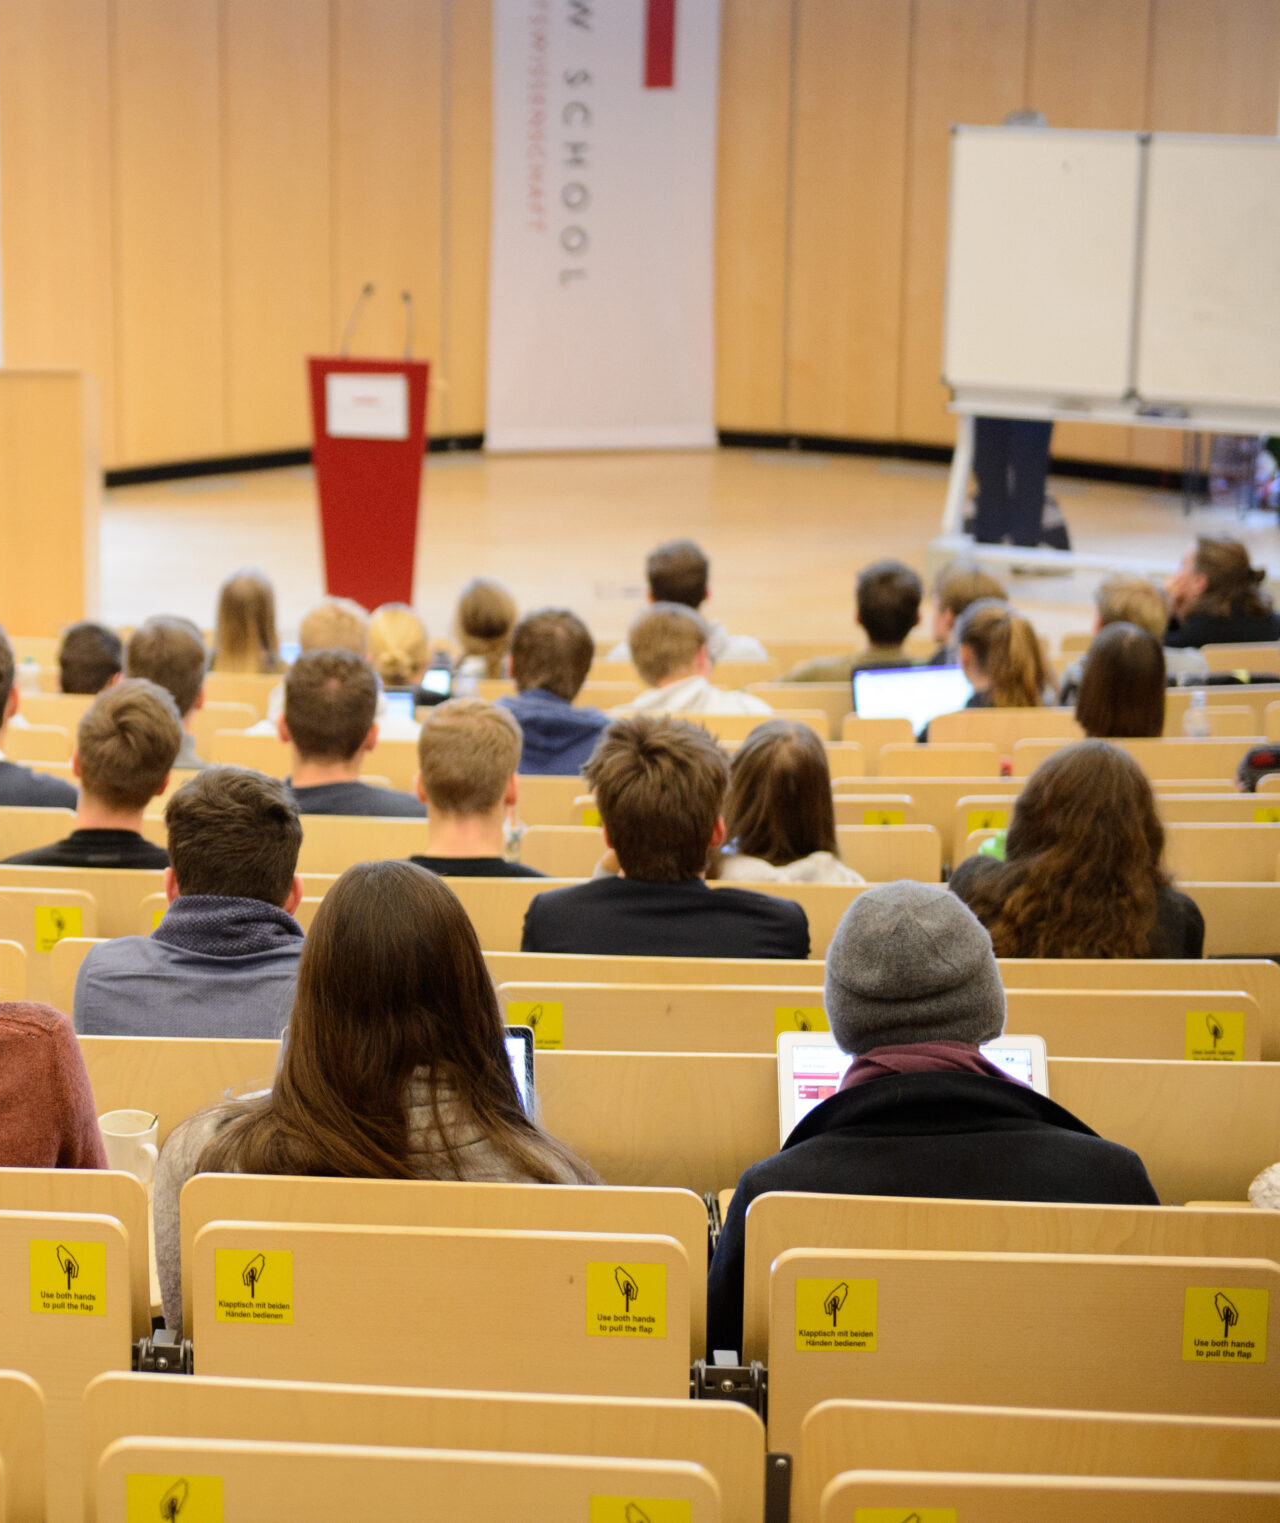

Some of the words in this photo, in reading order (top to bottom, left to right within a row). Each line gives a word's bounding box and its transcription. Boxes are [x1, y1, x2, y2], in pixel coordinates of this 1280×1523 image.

[559, 68, 593, 288] SCHOOL
[56, 1292, 72, 1300] both
[74, 1293, 96, 1301] hands
[52, 1302, 65, 1310] pull
[67, 1302, 78, 1310] the
[80, 1303, 93, 1311] flap
[219, 1300, 253, 1308] Klapptisch
[226, 1310, 250, 1318] Händen
[253, 1311, 283, 1319] bedienen
[614, 1314, 630, 1322] both
[632, 1315, 655, 1323] hands
[609, 1324, 623, 1332] pull
[799, 1330, 835, 1338] Klapptisch
[1231, 1340, 1255, 1348] hands
[1206, 1350, 1220, 1358] pull
[1237, 1350, 1252, 1359] flap
